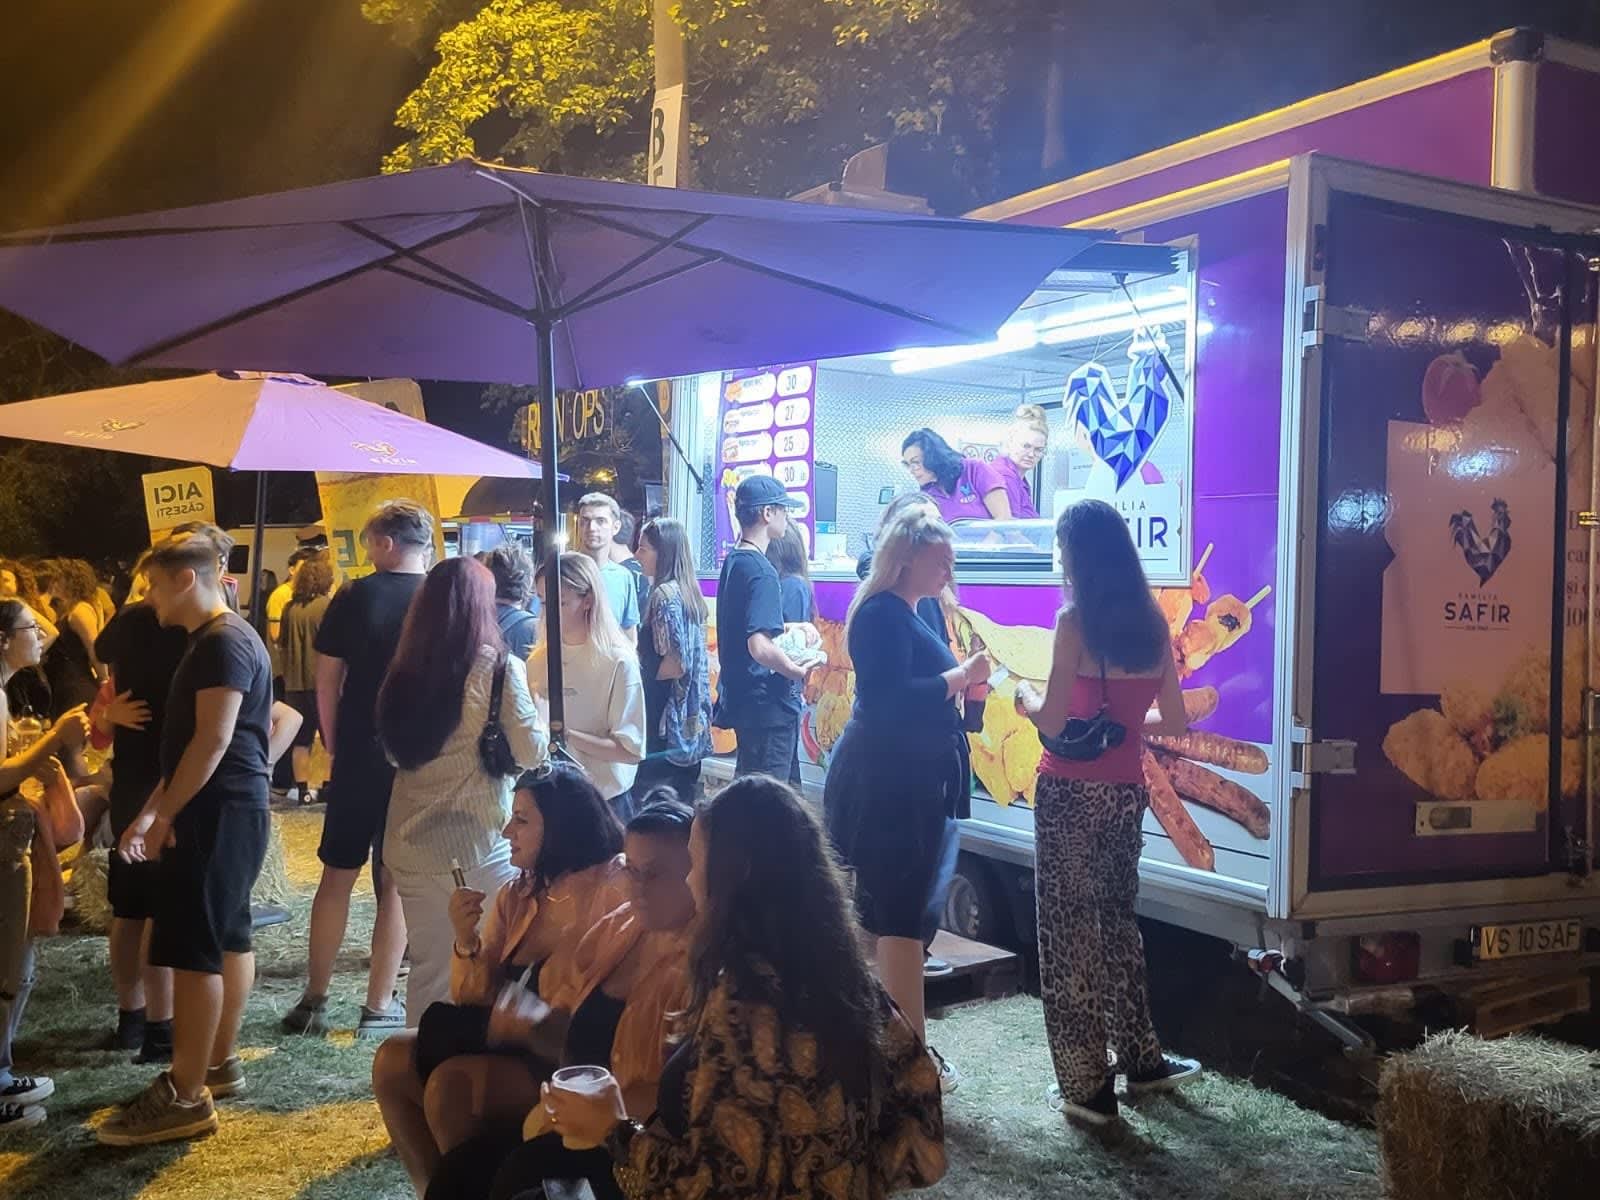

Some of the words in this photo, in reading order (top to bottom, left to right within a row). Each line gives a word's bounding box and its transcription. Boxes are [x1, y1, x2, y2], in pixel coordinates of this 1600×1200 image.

[786, 374, 797, 391] 30
[785, 404, 795, 421] 27
[784, 436, 794, 452] 25
[784, 466, 795, 482] 30
[1444, 602, 1511, 623] SAFIR
[1485, 928, 1510, 955] VS
[1518, 926, 1534, 953] 10
[1538, 922, 1579, 949] SAF
